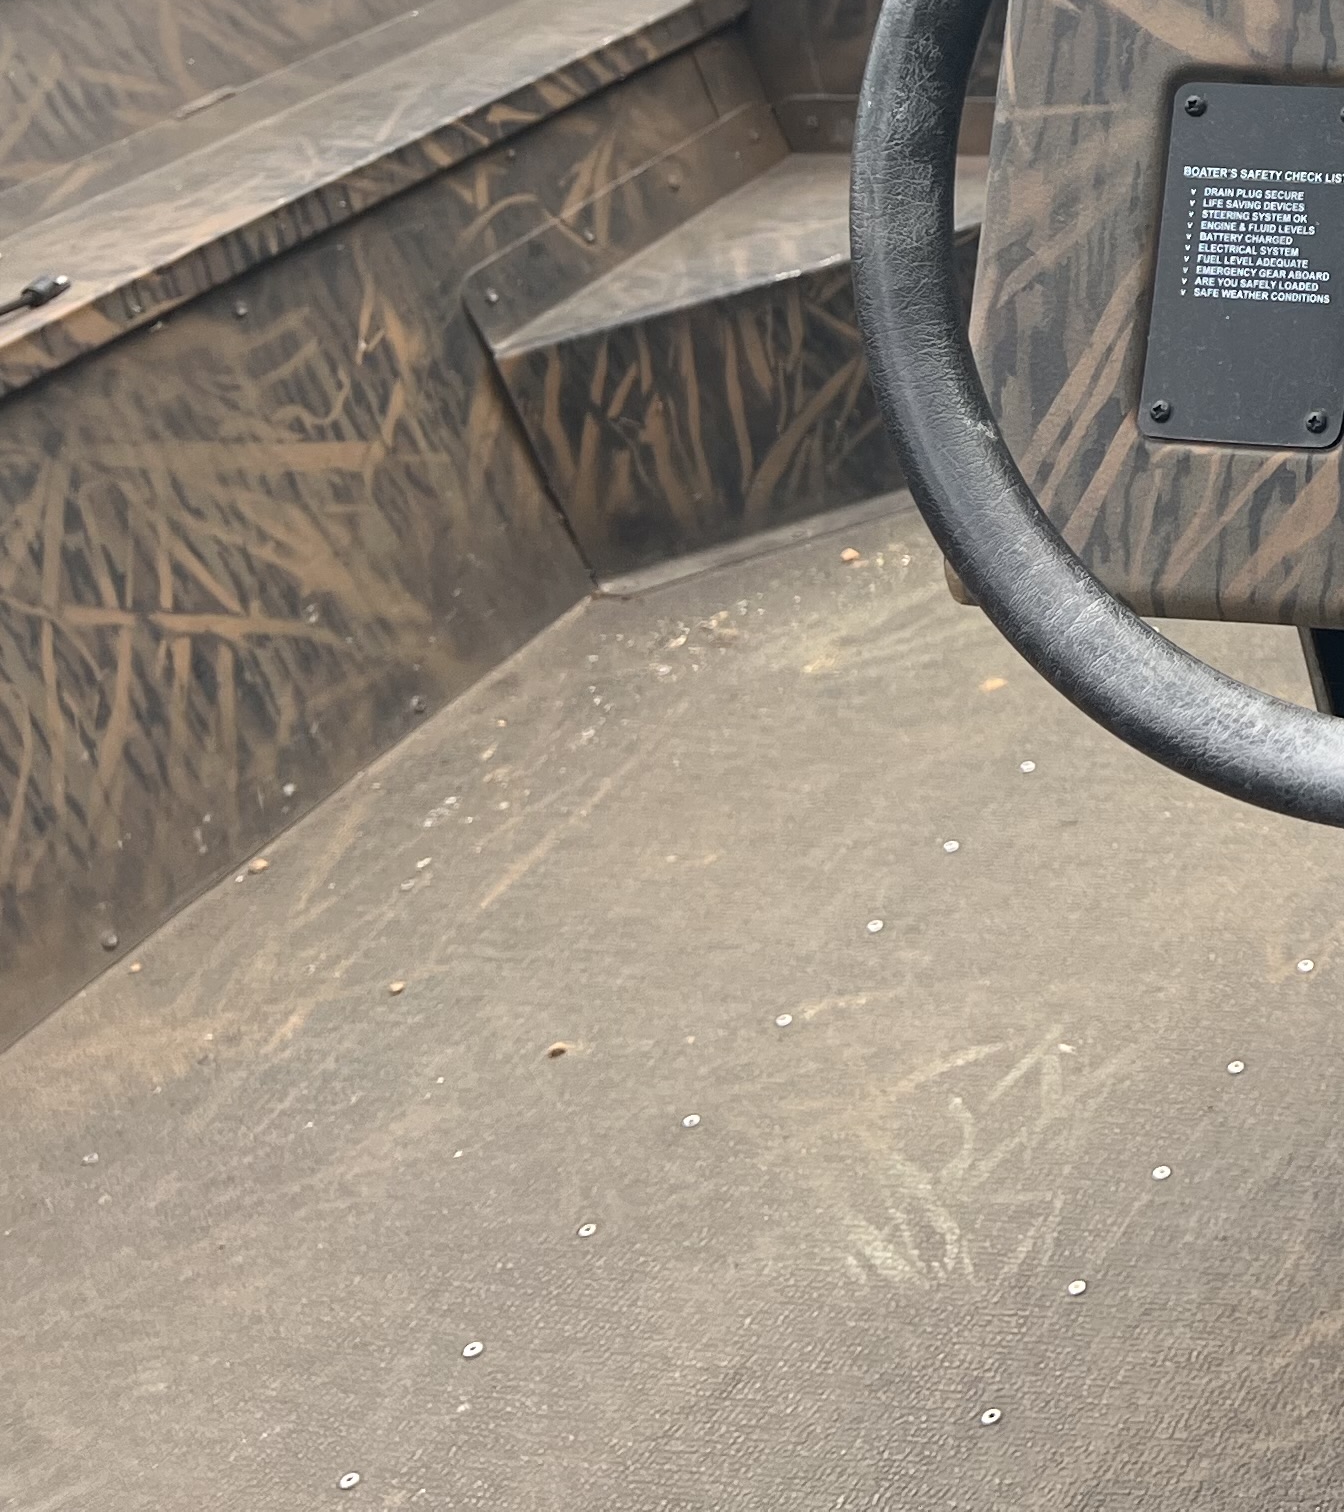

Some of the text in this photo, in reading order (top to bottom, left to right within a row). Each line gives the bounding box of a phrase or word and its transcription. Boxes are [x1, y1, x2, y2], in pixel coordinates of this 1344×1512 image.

[1183, 165, 1238, 179] BOATER'S
[1240, 168, 1283, 181] SAFETY
[1284, 170, 1323, 183] CHECK
[1204, 187, 1305, 201] DRAIN PLUG SECURE
[1203, 198, 1305, 212] LIFE SAVING DEVICES
[1201, 209, 1308, 223] STEERING SYSTEM OK
[1200, 220, 1316, 236] ENGINE & FLUID LEVELS
[1199, 231, 1293, 245] BATTERY CHARGED
[1198, 243, 1300, 257] ELECTRICAL SYSTEM
[1197, 254, 1309, 268] FUEL LEVEL ADEQUATE
[1195, 265, 1330, 281] EMERGENCY GEAR ABOARD
[1194, 276, 1319, 292] ARE YOU SAFELY LOADED
[1193, 287, 1331, 304] SAFE WEATHER CONDITIONS
